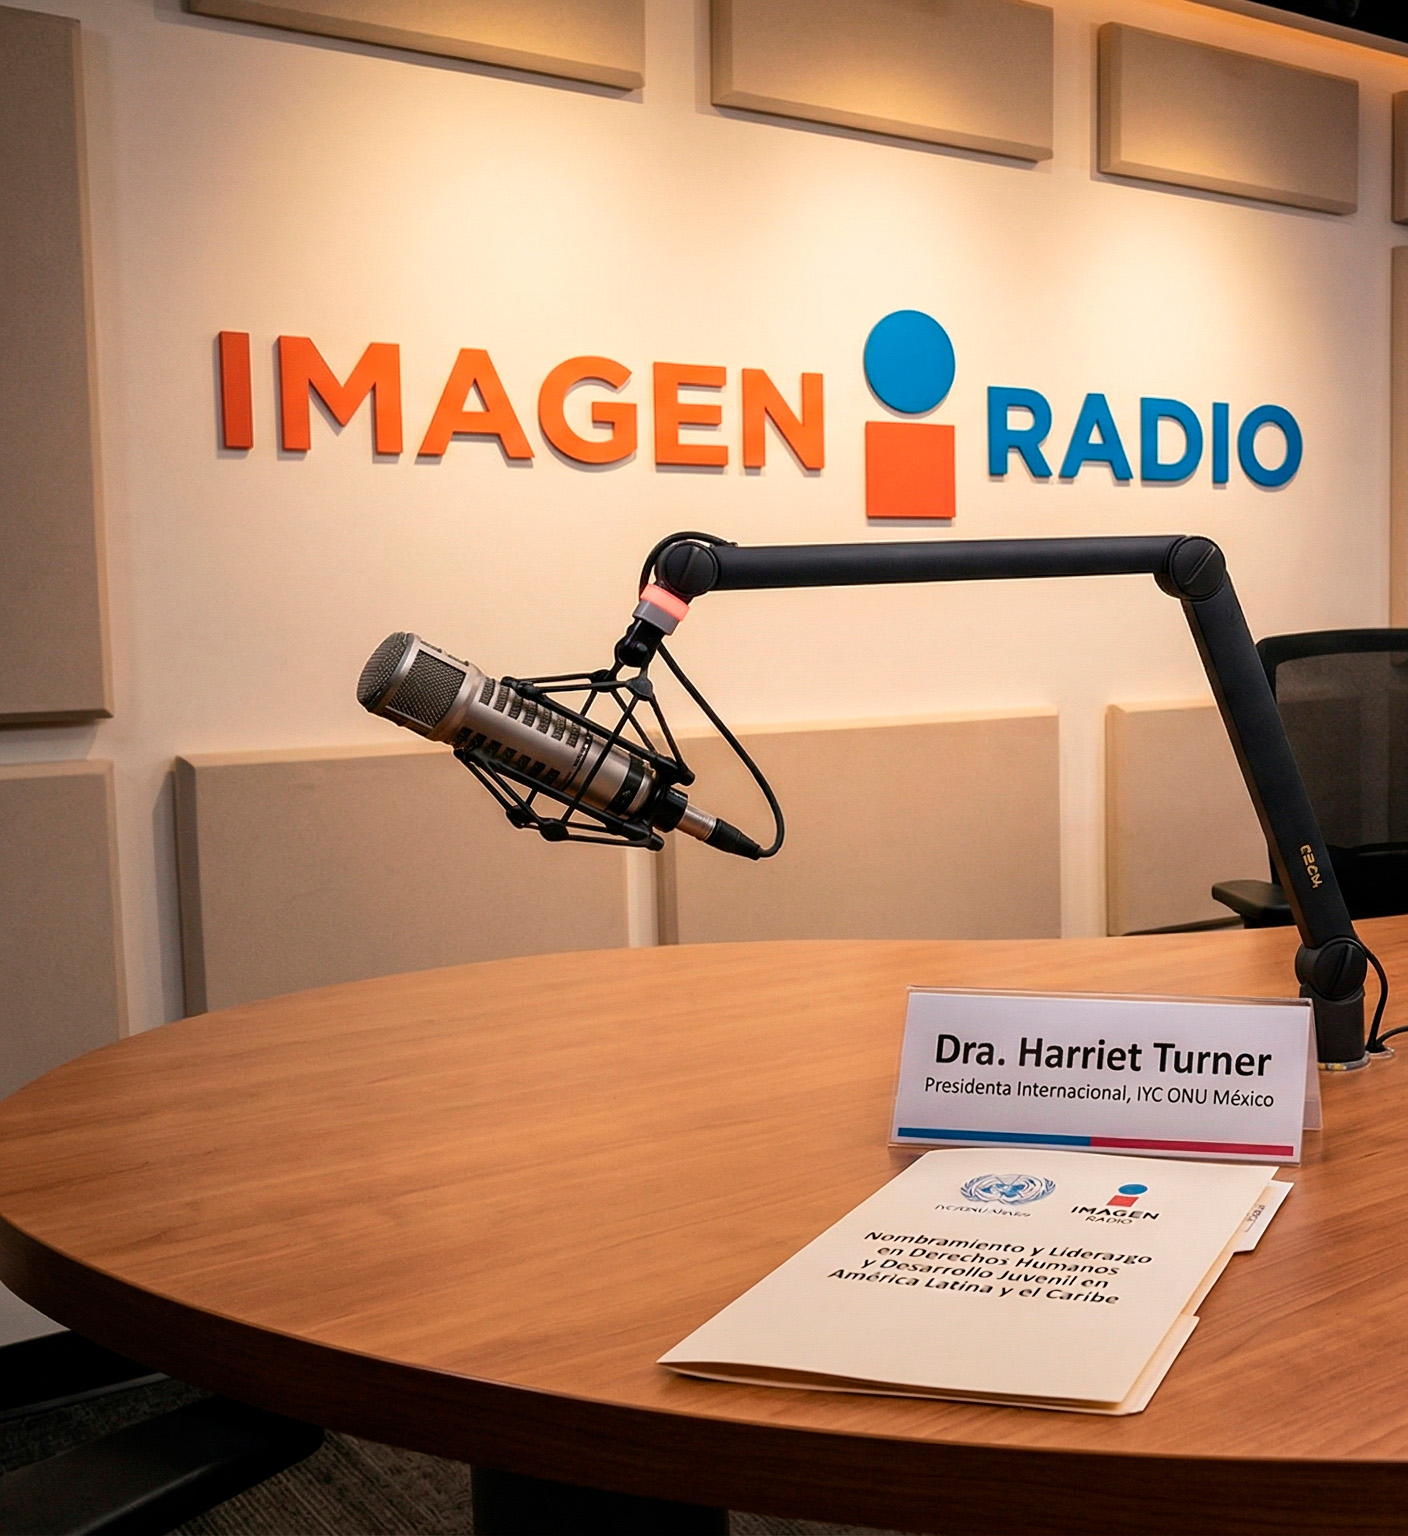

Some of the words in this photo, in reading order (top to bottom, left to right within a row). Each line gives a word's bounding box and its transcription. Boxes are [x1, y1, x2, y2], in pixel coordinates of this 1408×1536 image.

[218, 330, 826, 471] IMAGEN
[986, 384, 1304, 488] RADIO
[935, 1033, 1006, 1067] Dra.
[1018, 1037, 1142, 1073] Harriet
[1152, 1042, 1272, 1077] Turner
[924, 1077, 1012, 1097] Presidenta
[1017, 1081, 1132, 1105] Internacional,
[1136, 1086, 1164, 1104] IYC
[1167, 1088, 1209, 1106] ONU
[1213, 1088, 1275, 1108] México
[1070, 1206, 1161, 1221] IMAGEN
[864, 1231, 1025, 1252] Nombramiento
[1029, 1246, 1045, 1257] y
[1049, 1246, 1153, 1265] Liderazgo
[877, 1247, 904, 1256] en
[909, 1248, 1010, 1266] Derechos
[1015, 1257, 1121, 1276] Humanos
[826, 1268, 920, 1287] América
[924, 1277, 994, 1294] Latina
[998, 1286, 1014, 1298] y
[1018, 1287, 1042, 1298] el
[1045, 1289, 1120, 1305] Caribe
[860, 1258, 877, 1269] y
[879, 1259, 994, 1279] Desarrollo
[996, 1270, 1078, 1287] Juvenil
[1080, 1279, 1110, 1289] en
